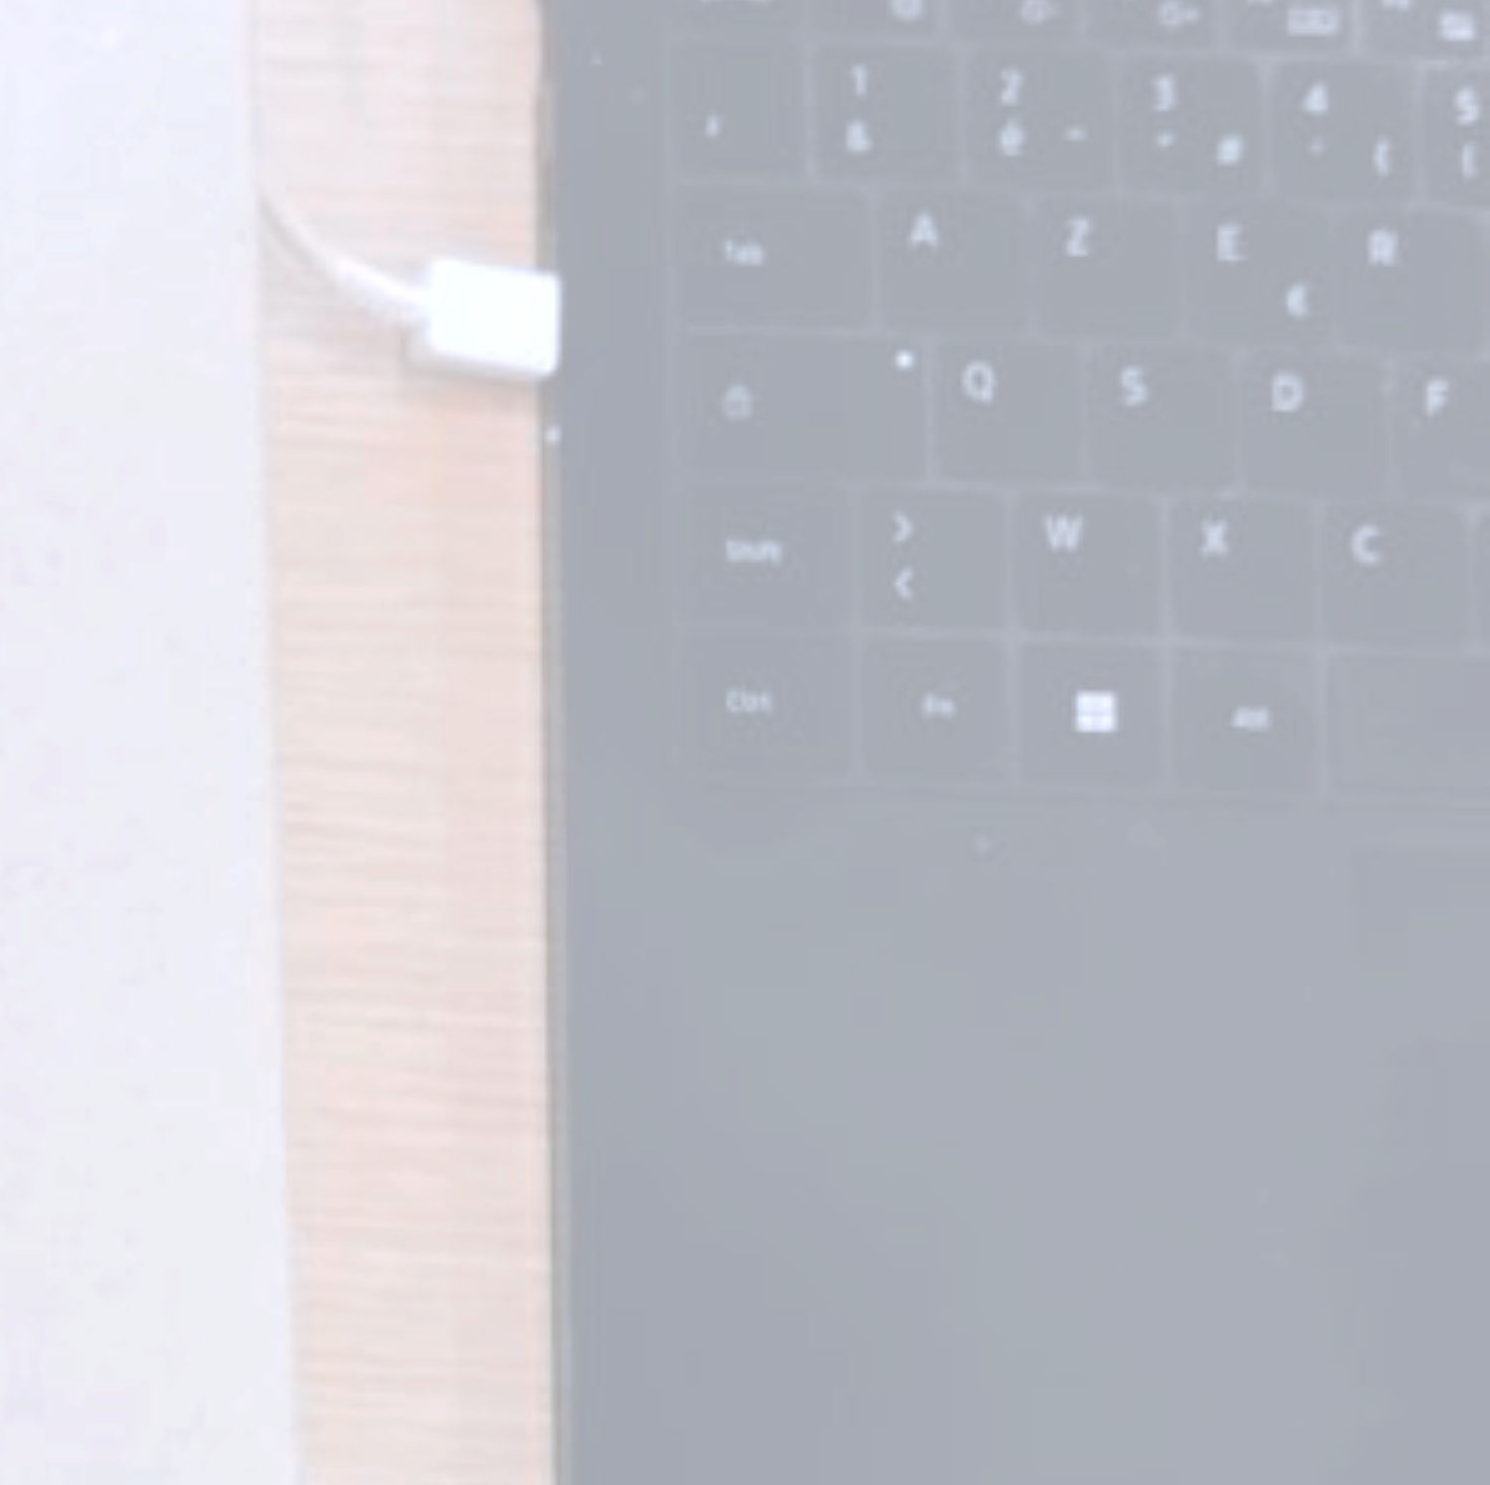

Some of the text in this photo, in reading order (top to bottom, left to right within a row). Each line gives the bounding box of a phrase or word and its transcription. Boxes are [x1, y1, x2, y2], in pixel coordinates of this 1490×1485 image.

[907, 210, 943, 252] A
[1064, 215, 1095, 259] Z
[1215, 221, 1247, 265] E
[959, 359, 1000, 408] Q
[1116, 364, 1152, 408] S
[1267, 370, 1309, 416] D
[1421, 375, 1453, 420] F
[1041, 512, 1085, 554] W
[1198, 515, 1232, 560] X
[1348, 523, 1388, 569] C
